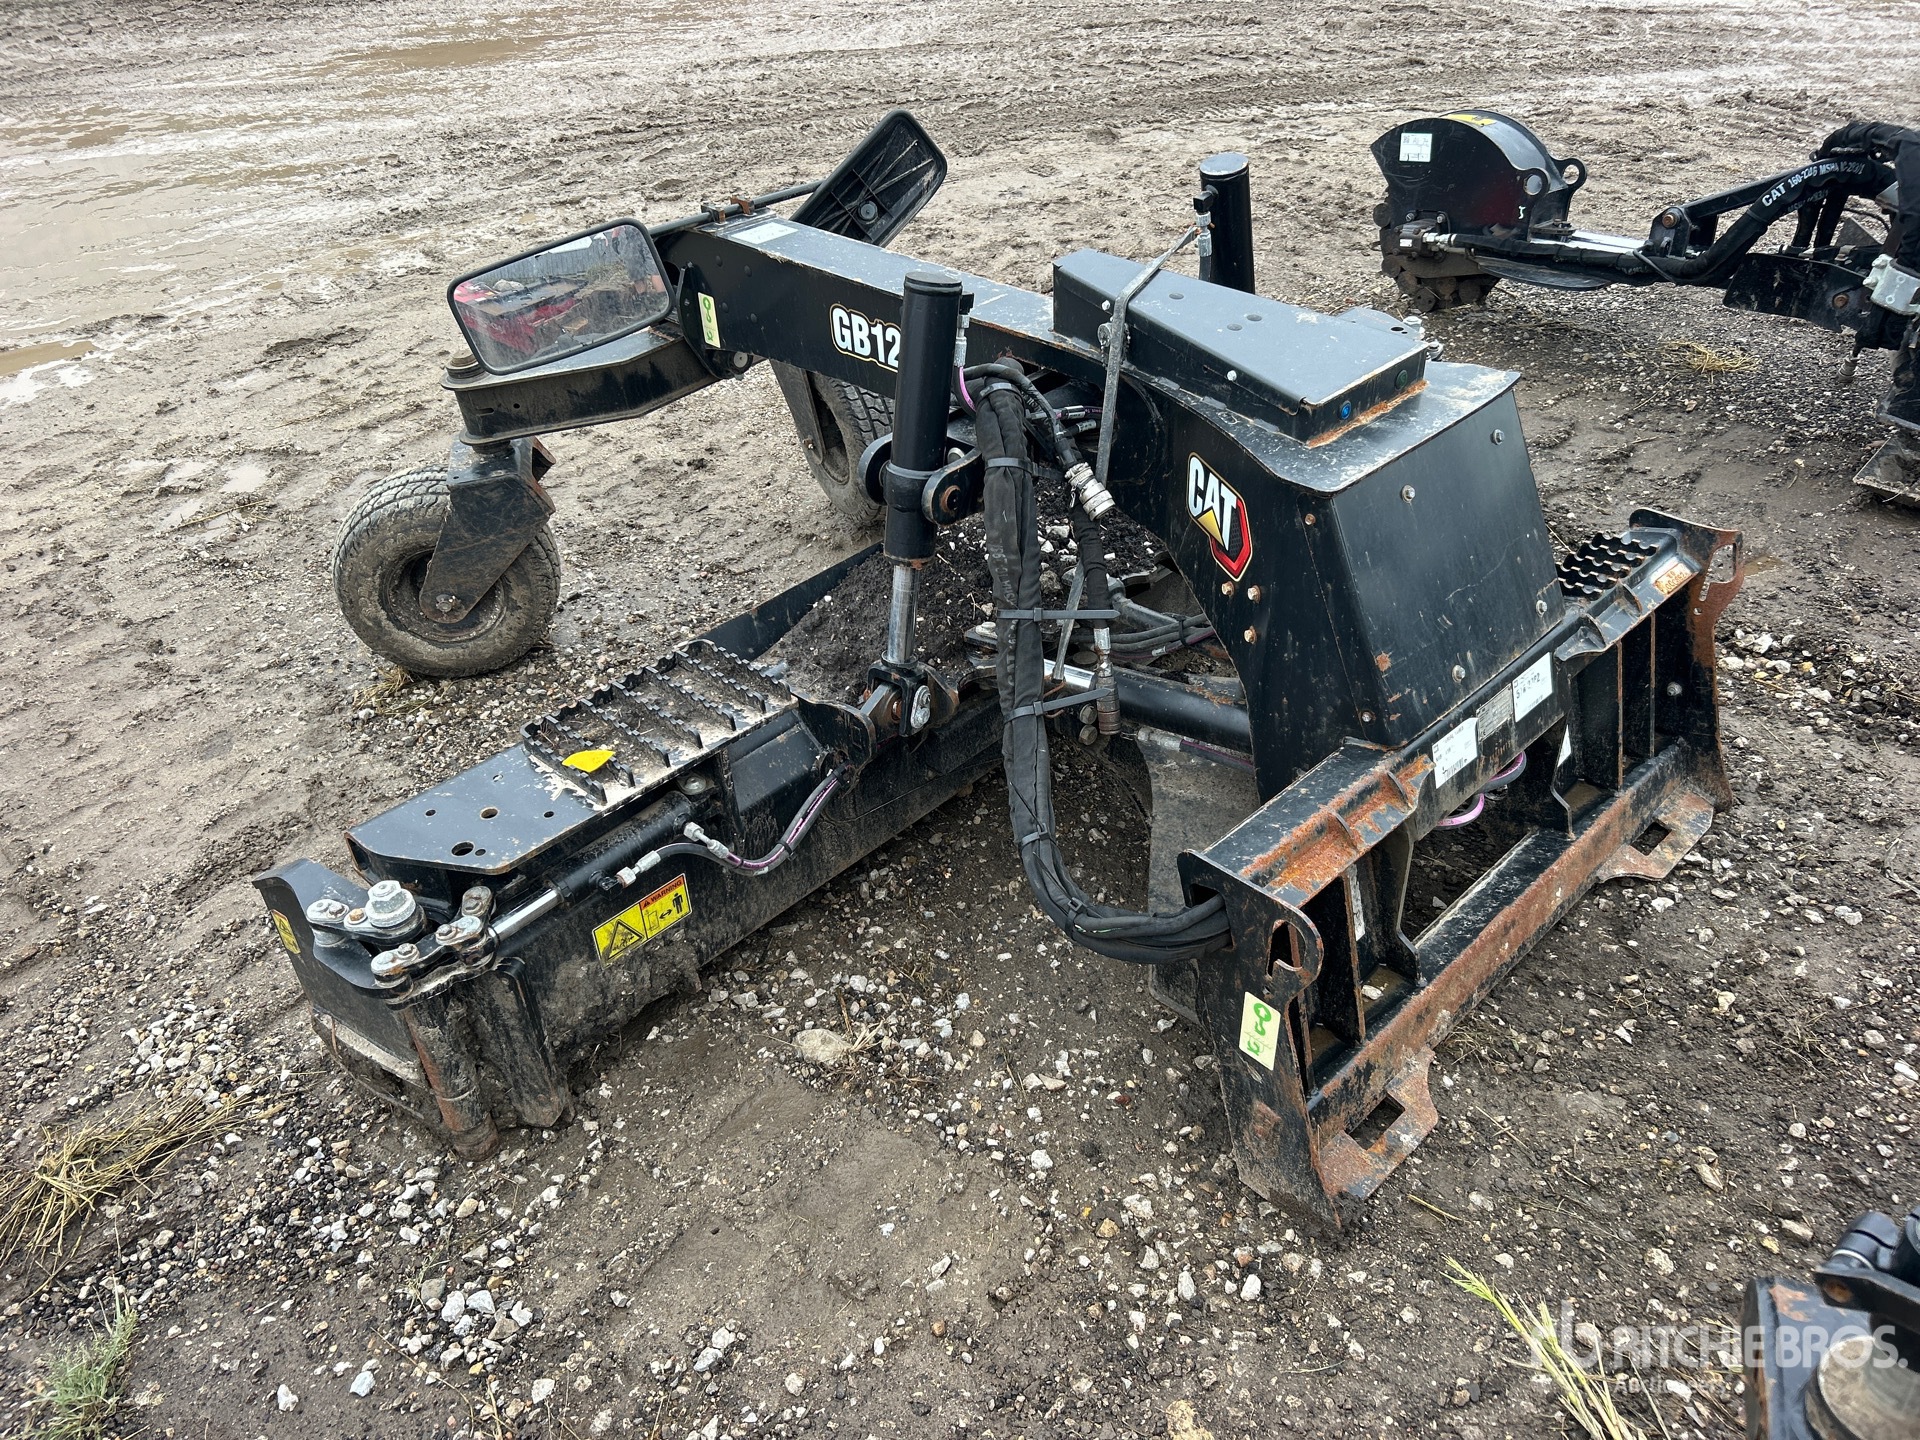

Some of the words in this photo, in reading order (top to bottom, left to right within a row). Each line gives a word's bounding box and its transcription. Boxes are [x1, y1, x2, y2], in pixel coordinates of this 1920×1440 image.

[1762, 182, 1786, 207] CAT
[1188, 456, 1237, 551] CAT
[651, 880, 682, 902] WARNING
